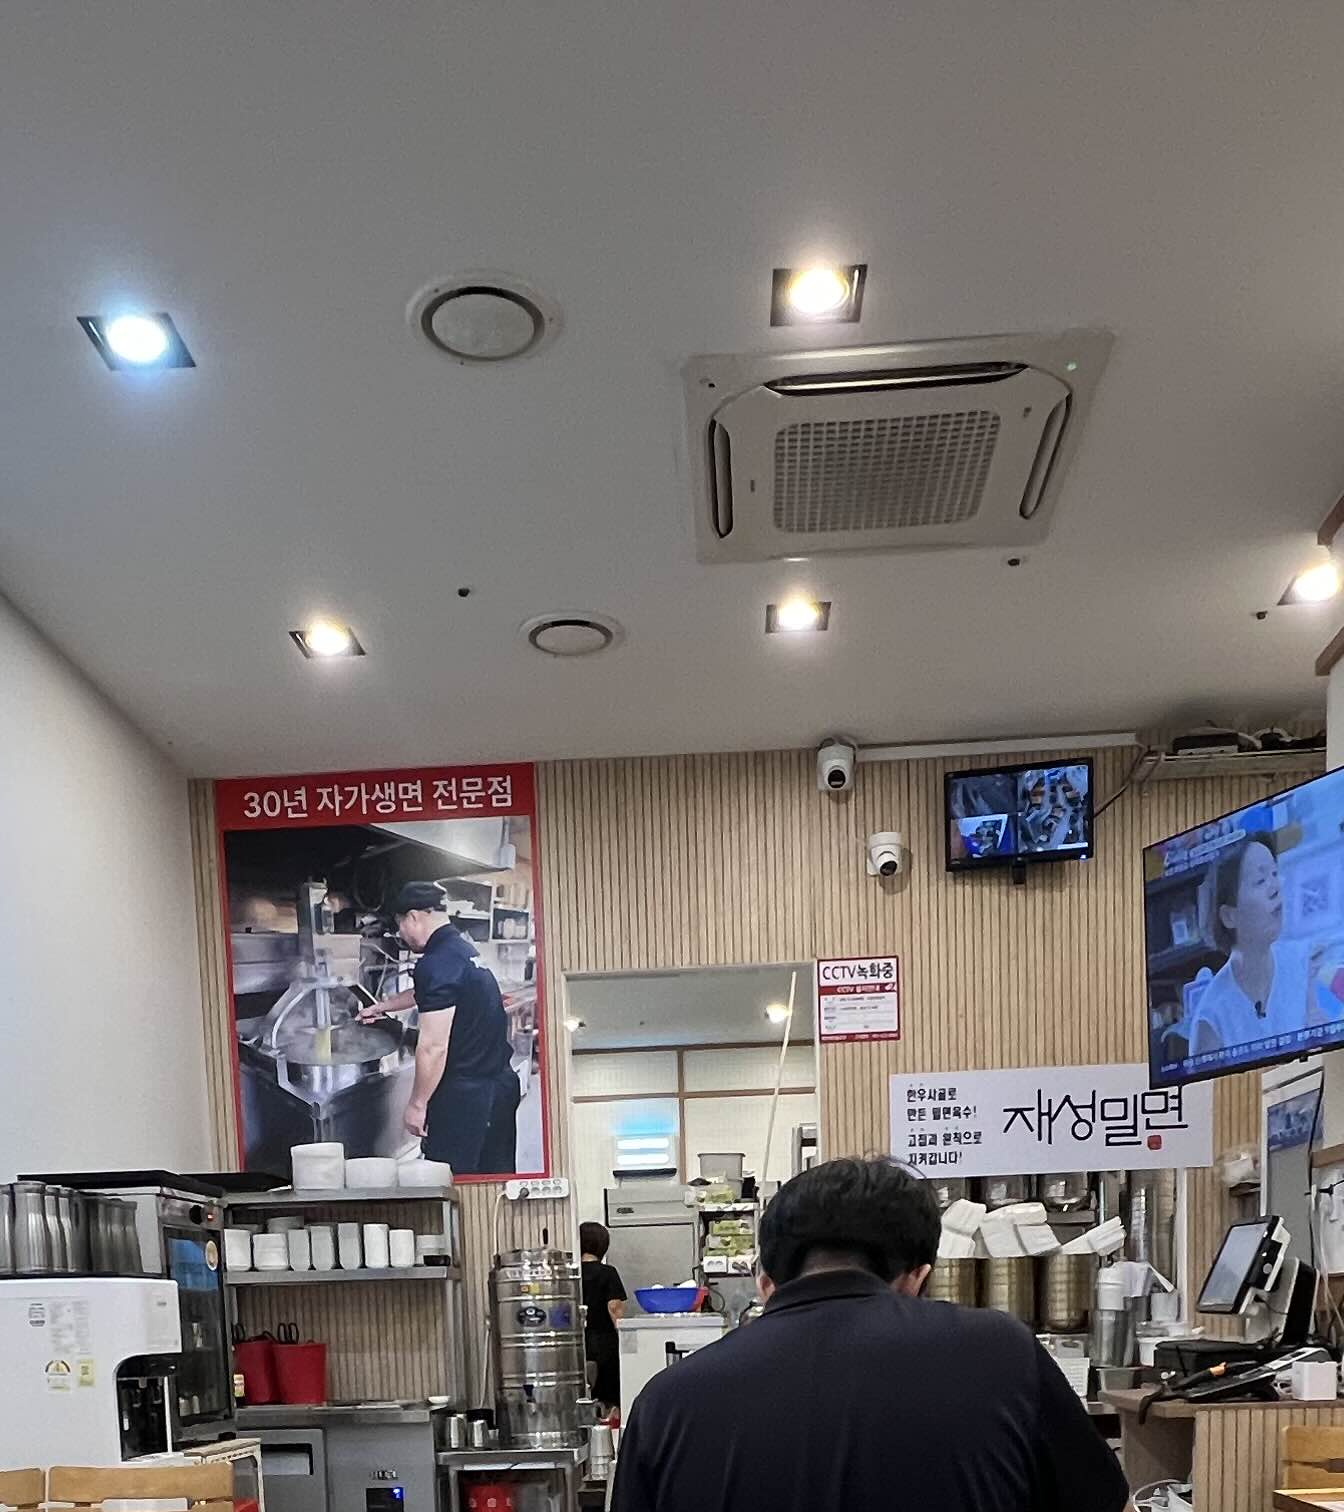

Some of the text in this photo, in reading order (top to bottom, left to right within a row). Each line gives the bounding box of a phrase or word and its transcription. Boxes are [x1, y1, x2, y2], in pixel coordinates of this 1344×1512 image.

[243, 774, 513, 819] 30년 자가생면 전문점
[822, 962, 894, 980] CCTV녹화중
[1002, 1085, 1189, 1148] 재성밀면
